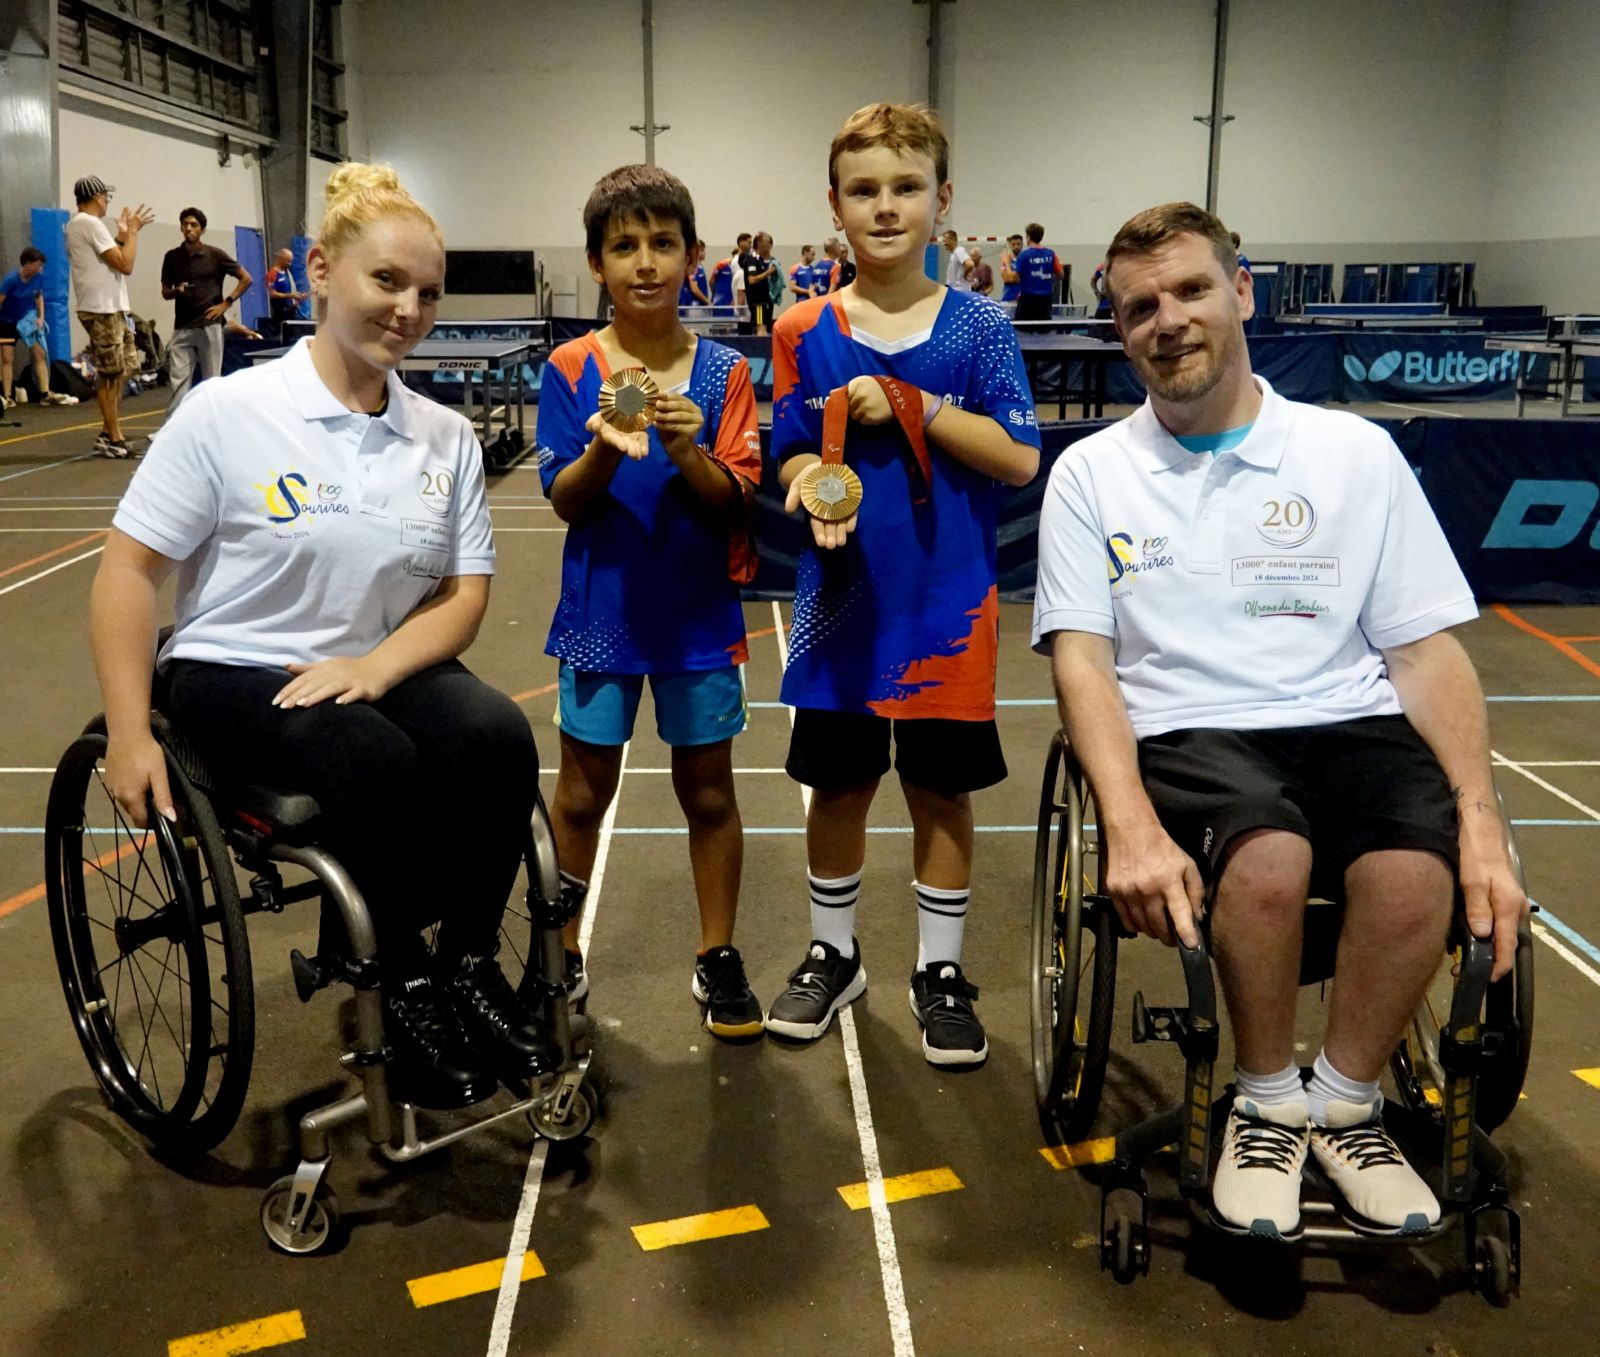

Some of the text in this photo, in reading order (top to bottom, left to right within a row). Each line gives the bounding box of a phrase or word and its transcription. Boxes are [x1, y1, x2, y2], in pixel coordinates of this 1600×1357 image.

[438, 361, 482, 369] DONIC
[420, 471, 452, 497] 20
[1261, 500, 1305, 528] 20
[1268, 560, 1297, 569] enfant
